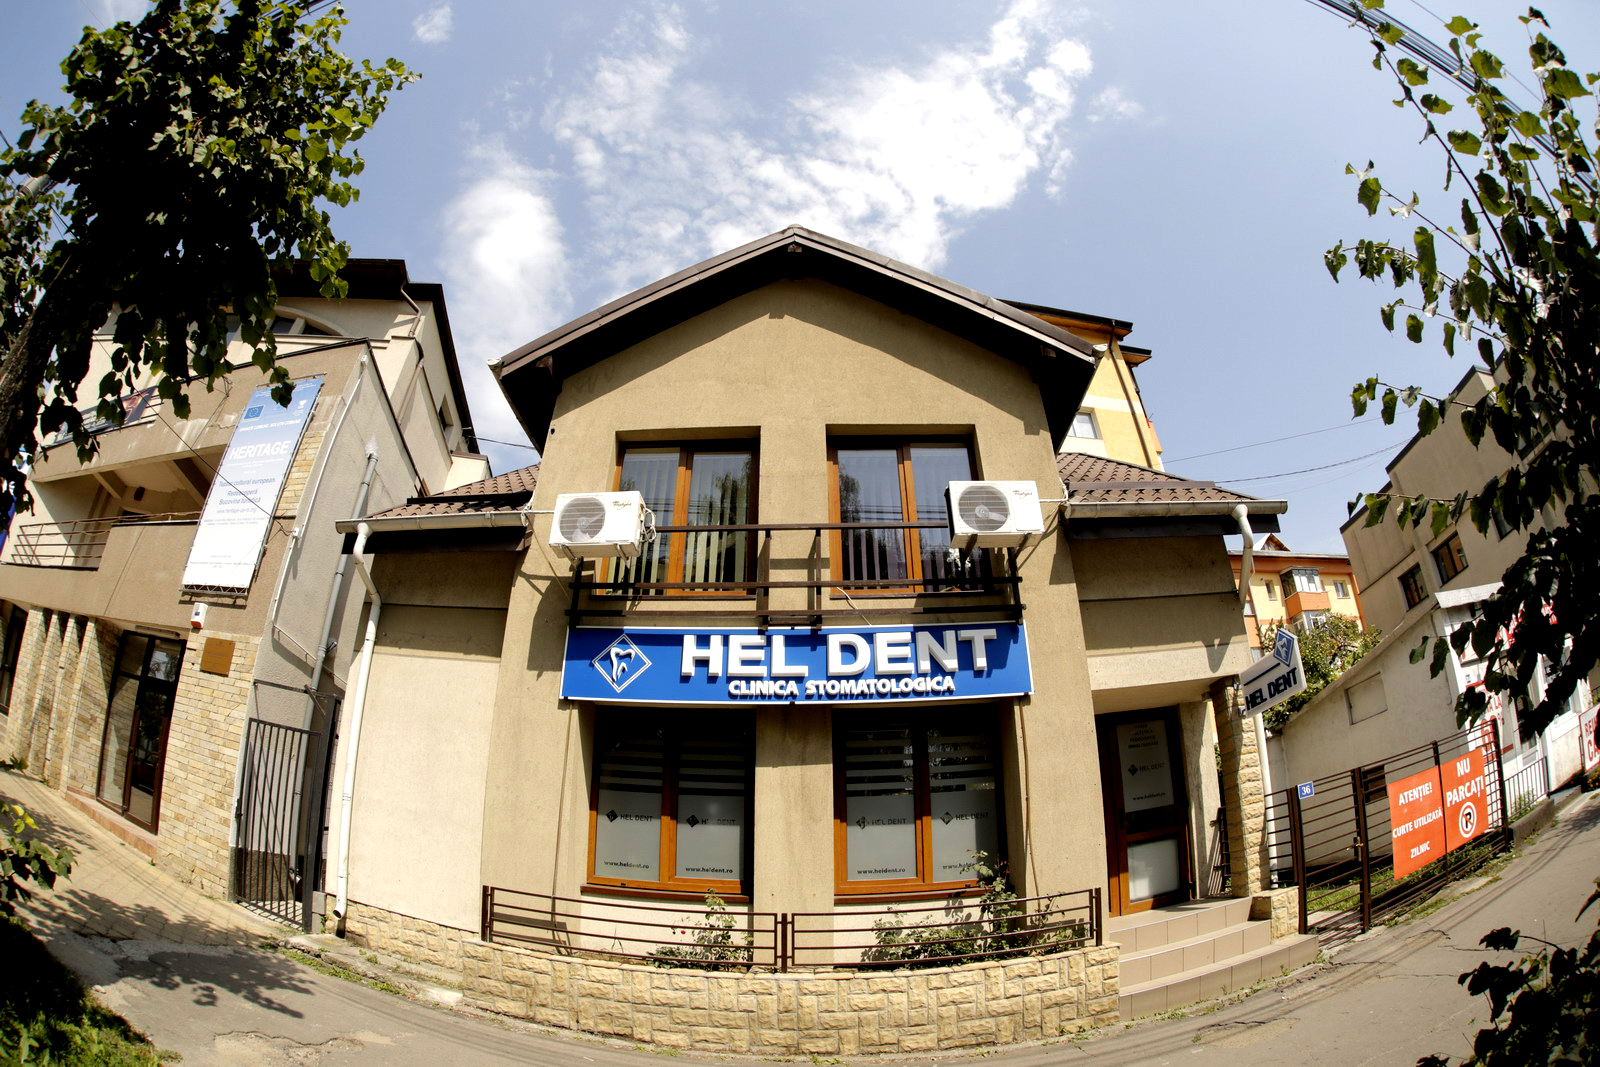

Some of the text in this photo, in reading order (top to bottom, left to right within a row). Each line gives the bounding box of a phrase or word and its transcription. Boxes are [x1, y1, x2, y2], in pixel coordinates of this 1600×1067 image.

[229, 440, 292, 460] HERITAGE
[681, 628, 997, 677] HEL DENT
[728, 675, 956, 696] CLINICA STOMATOLOGICA
[1245, 667, 1298, 711] HEL DENT
[1456, 757, 1471, 777] NU
[1301, 785, 1311, 796] 36
[620, 813, 653, 823] HEL DENT
[887, 817, 907, 826] DENT
[955, 811, 989, 821] HEL DENT
[1392, 821, 1414, 839] CURTE
[1410, 840, 1431, 859] ZILNIC
[857, 867, 906, 875] www.heldent.ro
